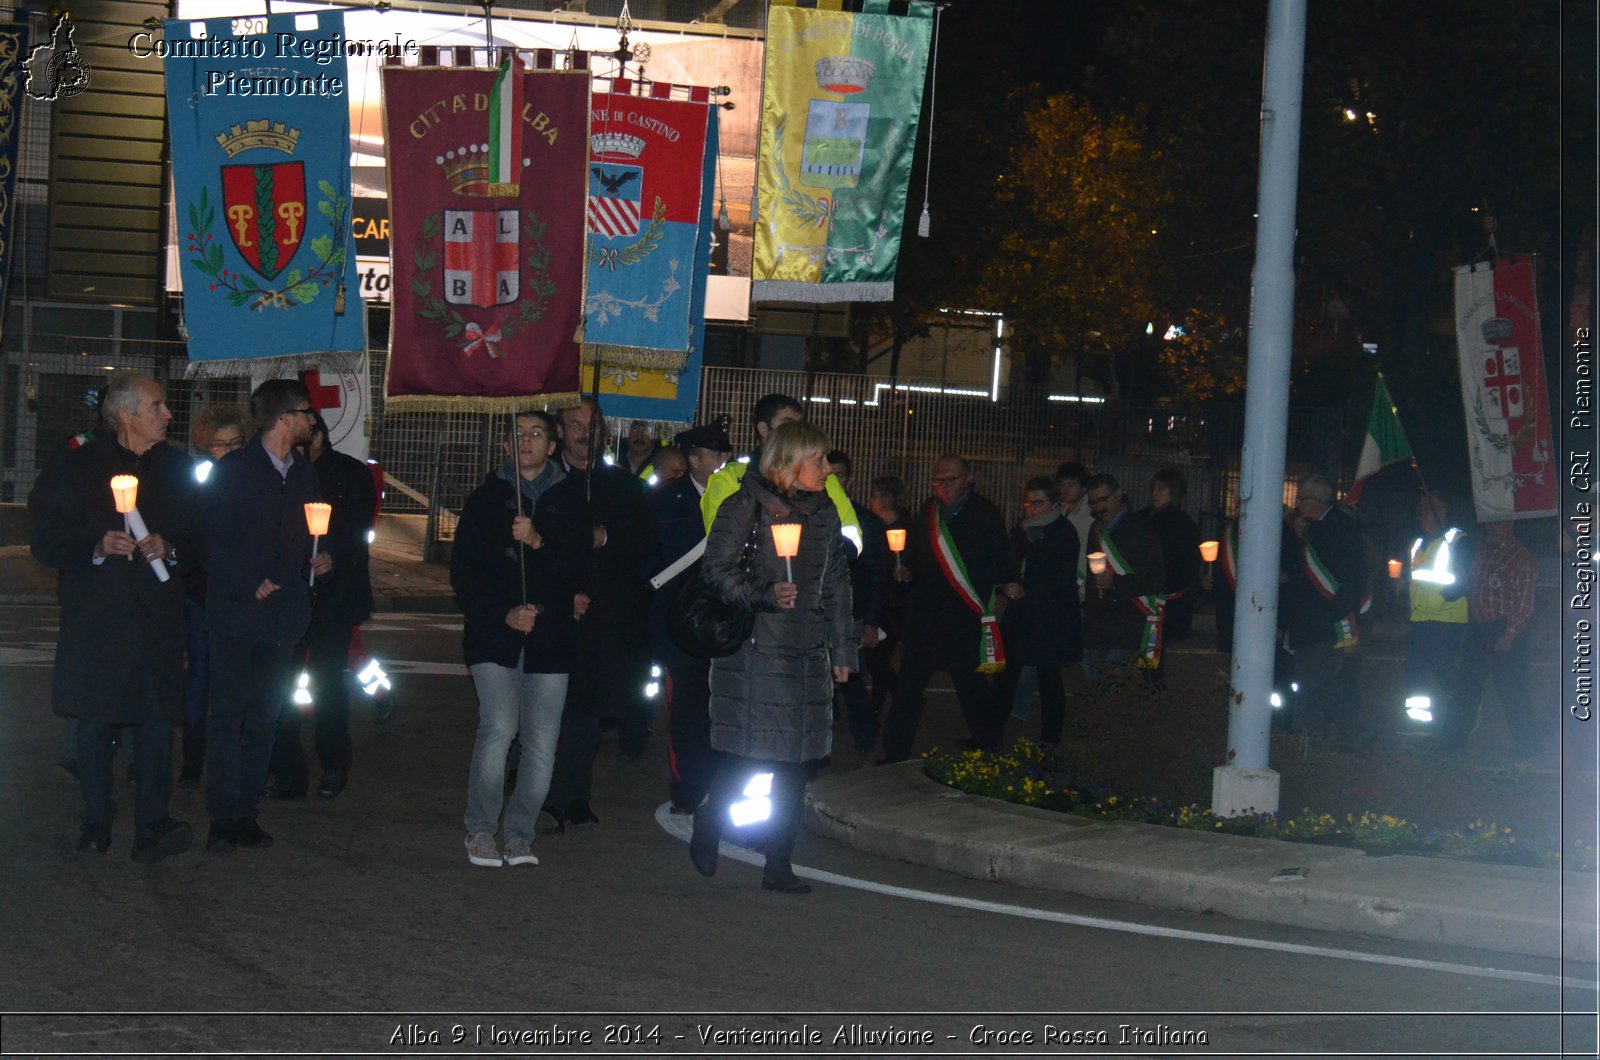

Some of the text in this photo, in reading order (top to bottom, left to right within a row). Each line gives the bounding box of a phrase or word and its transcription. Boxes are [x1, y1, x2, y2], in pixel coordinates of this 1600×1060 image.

[855, 21, 871, 38] DI
[873, 27, 915, 64] BOSIA
[474, 93, 489, 112] D
[521, 102, 560, 146] LBA
[614, 111, 624, 122] DI
[628, 111, 681, 143] CASTINO
[452, 218, 511, 235] A L
[452, 279, 511, 297] B A
